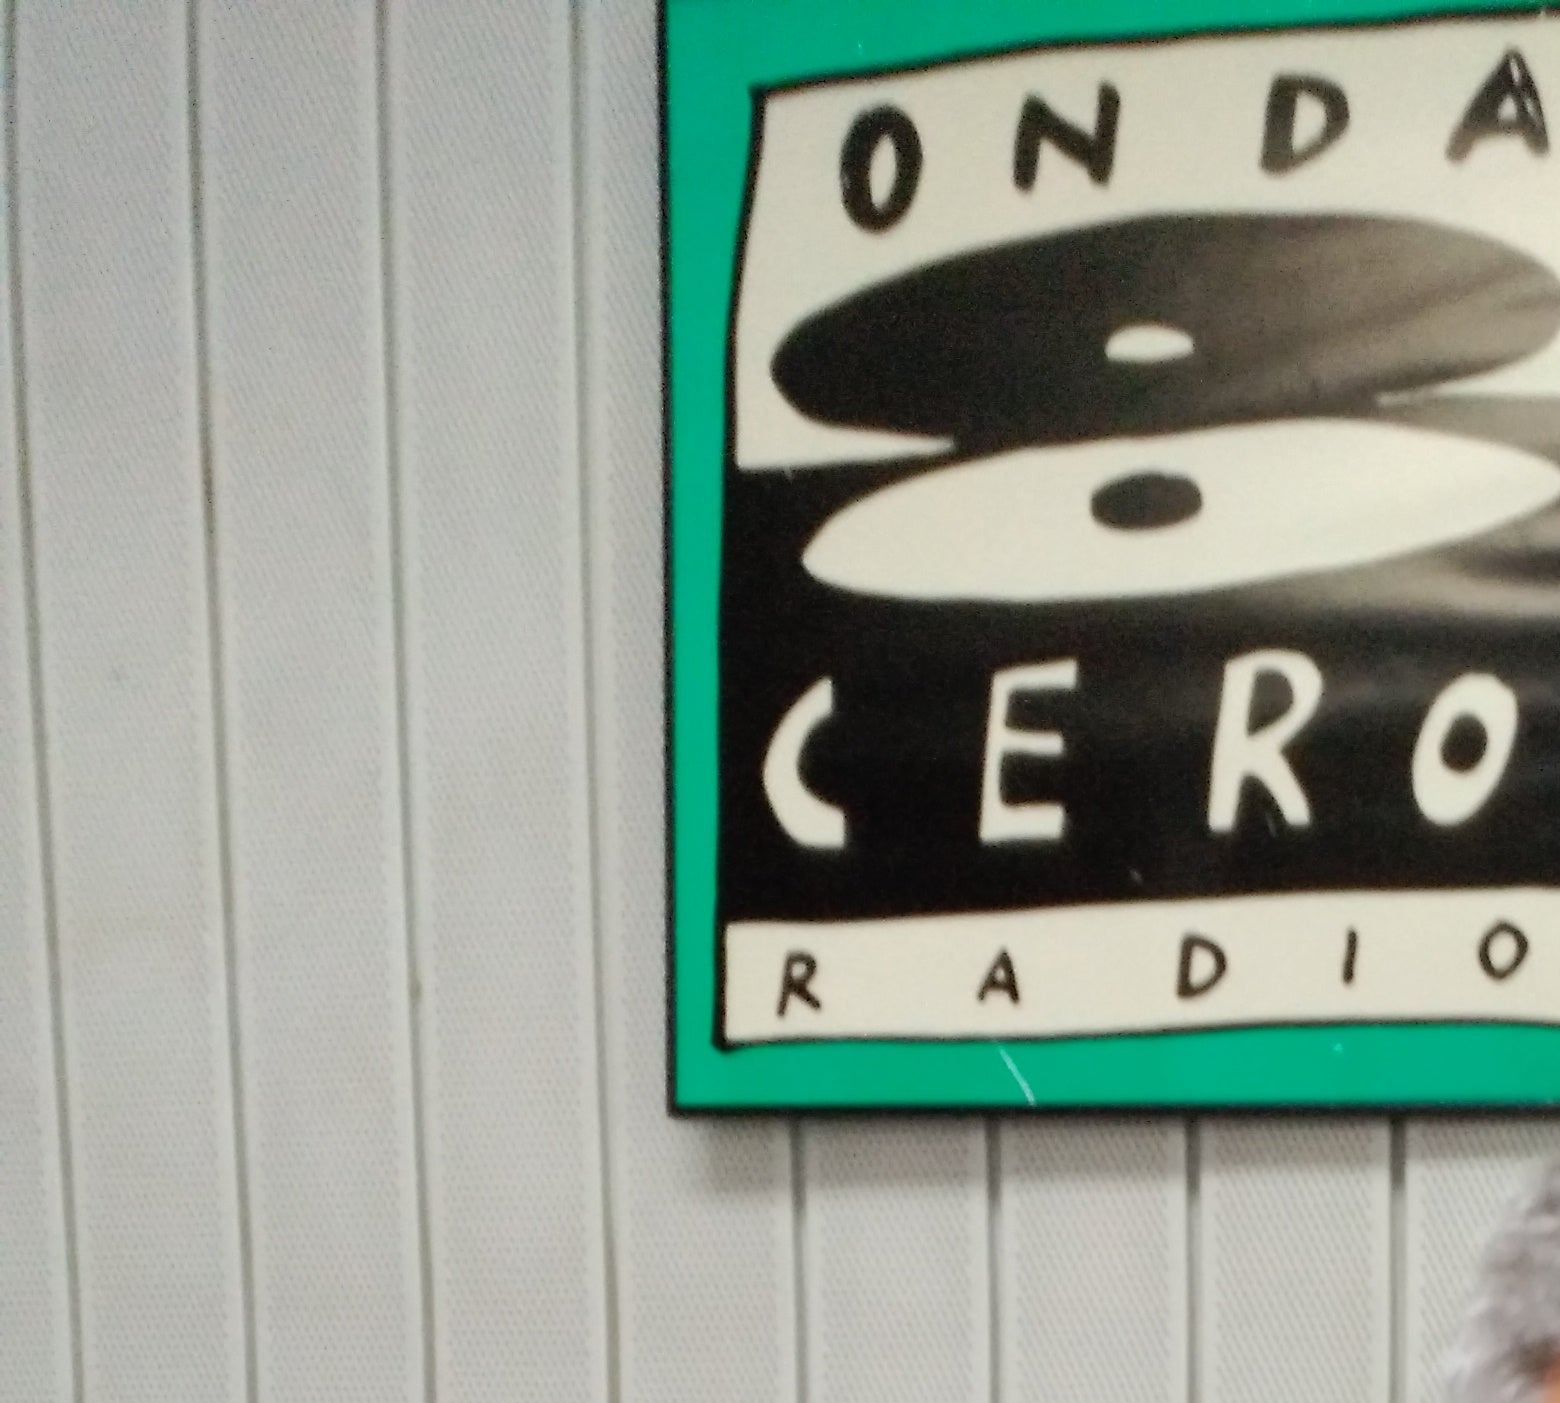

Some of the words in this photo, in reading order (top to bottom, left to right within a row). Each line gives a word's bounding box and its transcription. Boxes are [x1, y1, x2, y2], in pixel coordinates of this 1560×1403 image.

[838, 48, 1550, 236] ONDA
[762, 648, 1520, 849] CERO
[776, 920, 1530, 1018] RADIO
